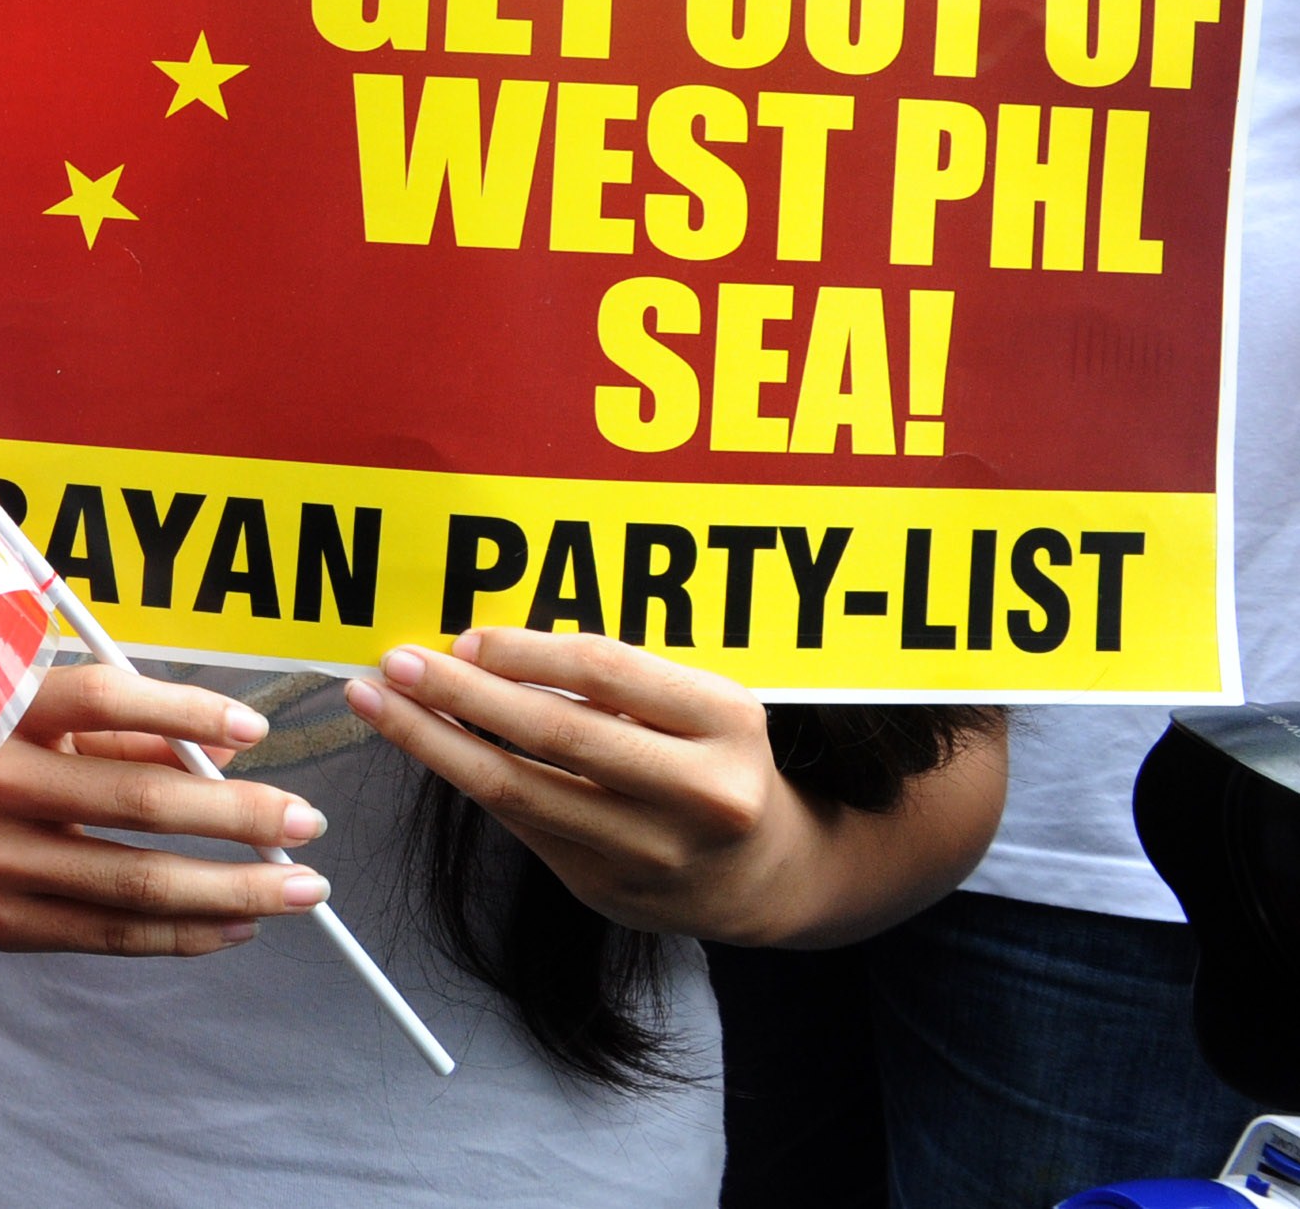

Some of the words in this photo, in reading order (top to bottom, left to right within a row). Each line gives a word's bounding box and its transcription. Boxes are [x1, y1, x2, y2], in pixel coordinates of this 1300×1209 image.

[353, 73, 854, 262] WEST
[890, 98, 1164, 274] PHL
[594, 276, 955, 457] SEA!
[440, 513, 1145, 654] PARTY-LIST
